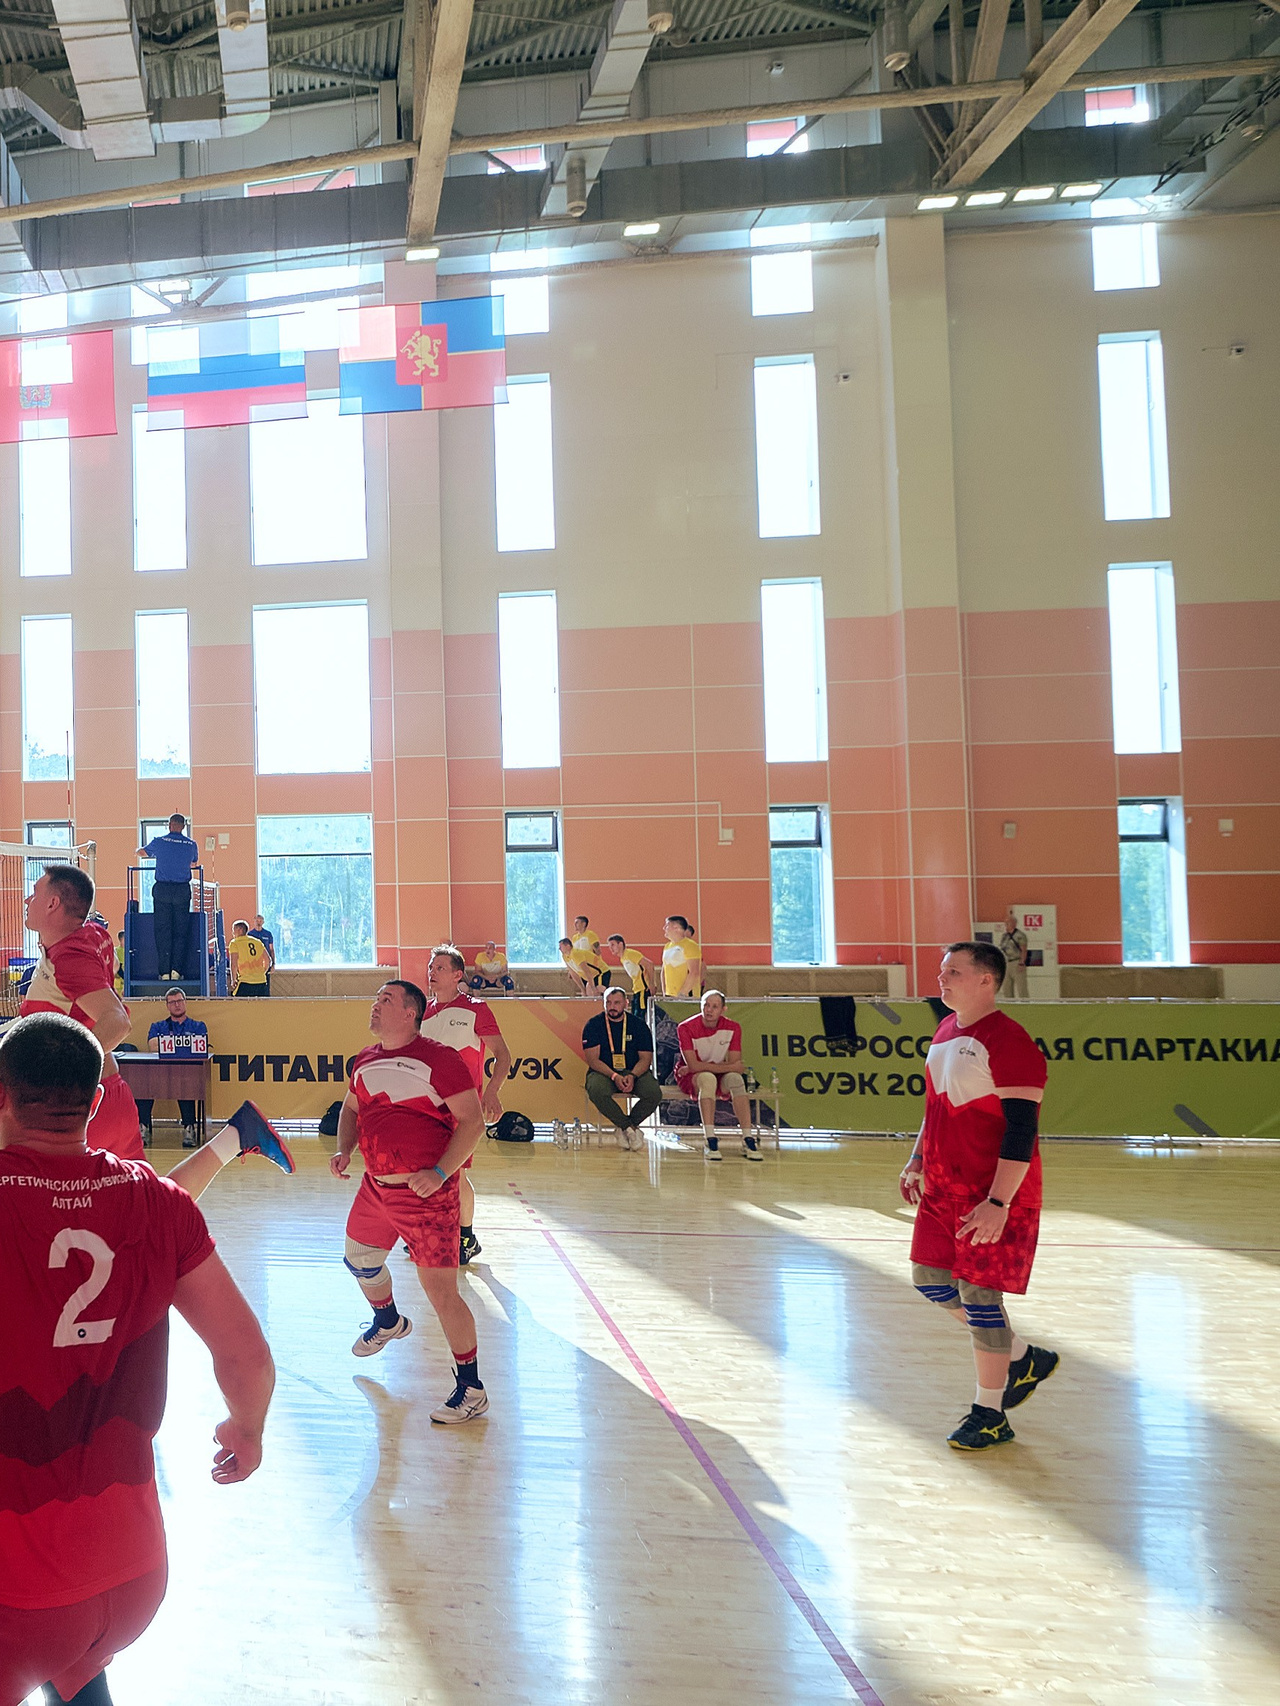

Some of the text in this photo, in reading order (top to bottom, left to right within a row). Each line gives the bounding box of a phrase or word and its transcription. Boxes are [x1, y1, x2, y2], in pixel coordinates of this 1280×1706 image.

[1026, 915, 1040, 926] ПК
[248, 942, 257, 957] 8
[161, 1039, 174, 1052] 14
[193, 1039, 206, 1052] 13
[761, 1034, 779, 1057] II
[1082, 1036, 1280, 1062] СПАРТАКИА
[213, 1054, 357, 1082] ТИТАН
[795, 1071, 926, 1097] СУЭК 20
[90, 1172, 136, 1192] ДИВИЗИ
[52, 1193, 93, 1210] АЛТАЙ
[48, 1227, 117, 1348] 2
